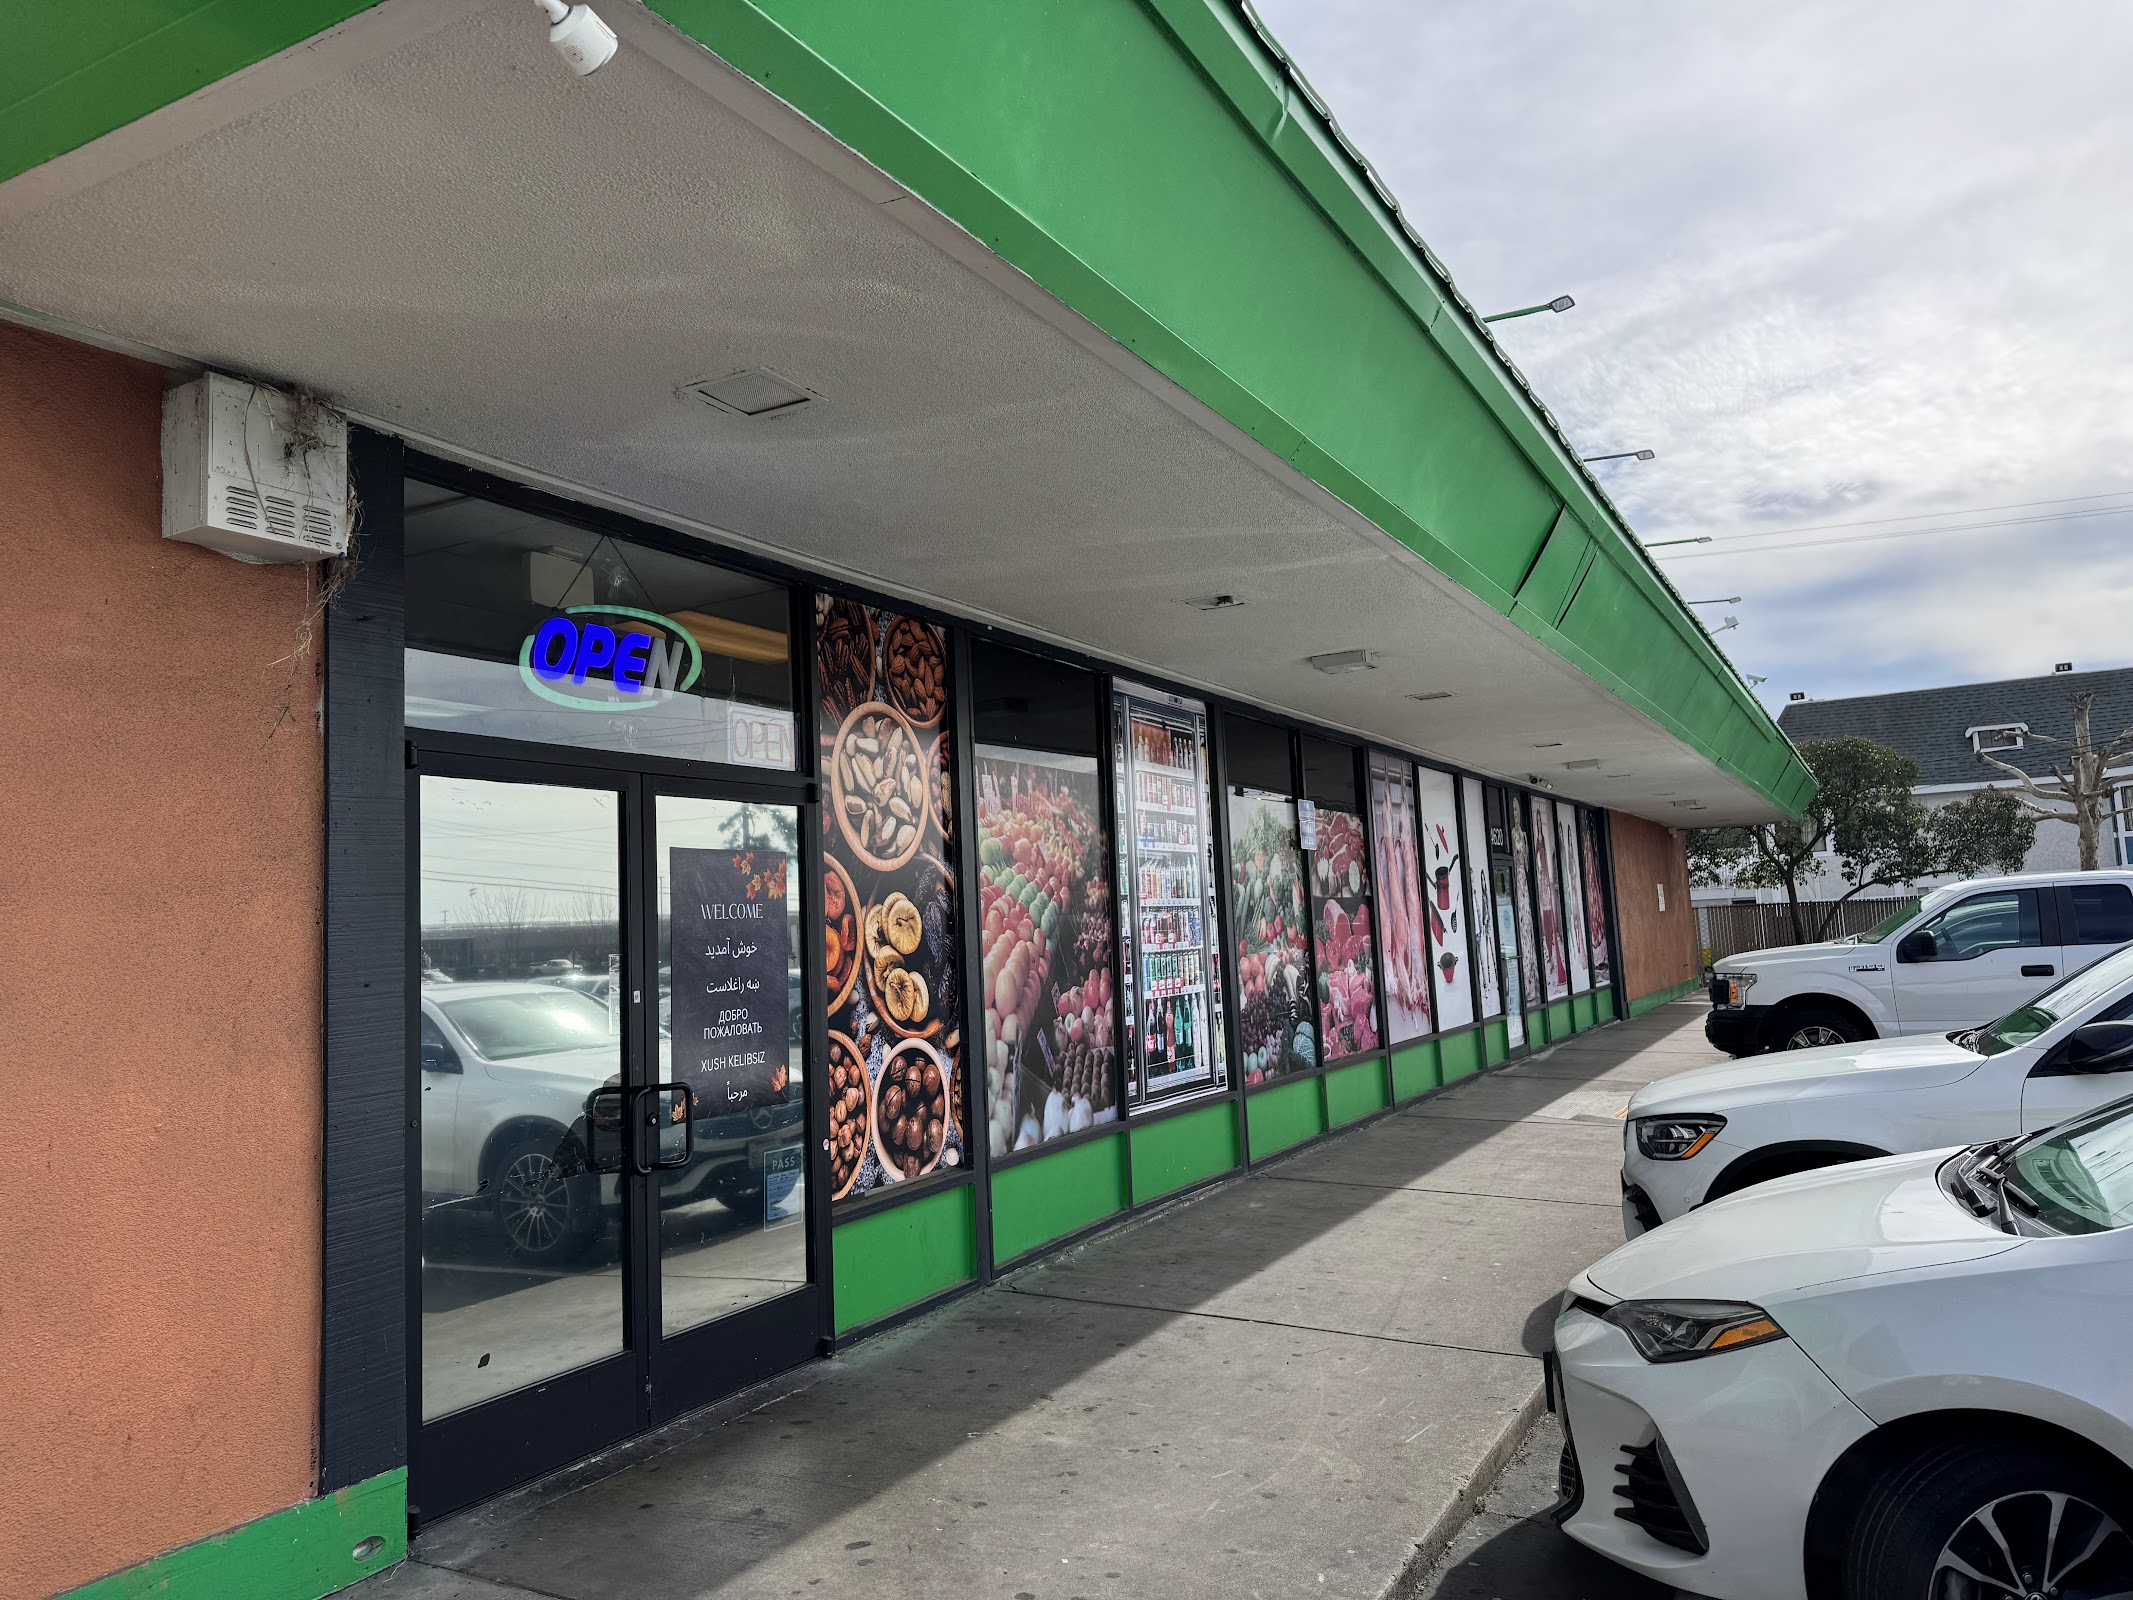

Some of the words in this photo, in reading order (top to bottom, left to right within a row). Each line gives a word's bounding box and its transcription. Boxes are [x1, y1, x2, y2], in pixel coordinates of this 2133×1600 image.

[533, 617, 684, 700] OPEN
[701, 903, 764, 920] WELCOME
[732, 940, 758, 958] خوش
[706, 976, 745, 994] راغلاست
[718, 1008, 749, 1025] ДОБРО
[703, 1021, 763, 1040] ПОЖАЛОВАТЬ
[700, 1057, 726, 1073] XUSH
[728, 1051, 766, 1068] KELIBSIZ
[772, 1156, 795, 1171] PASS
